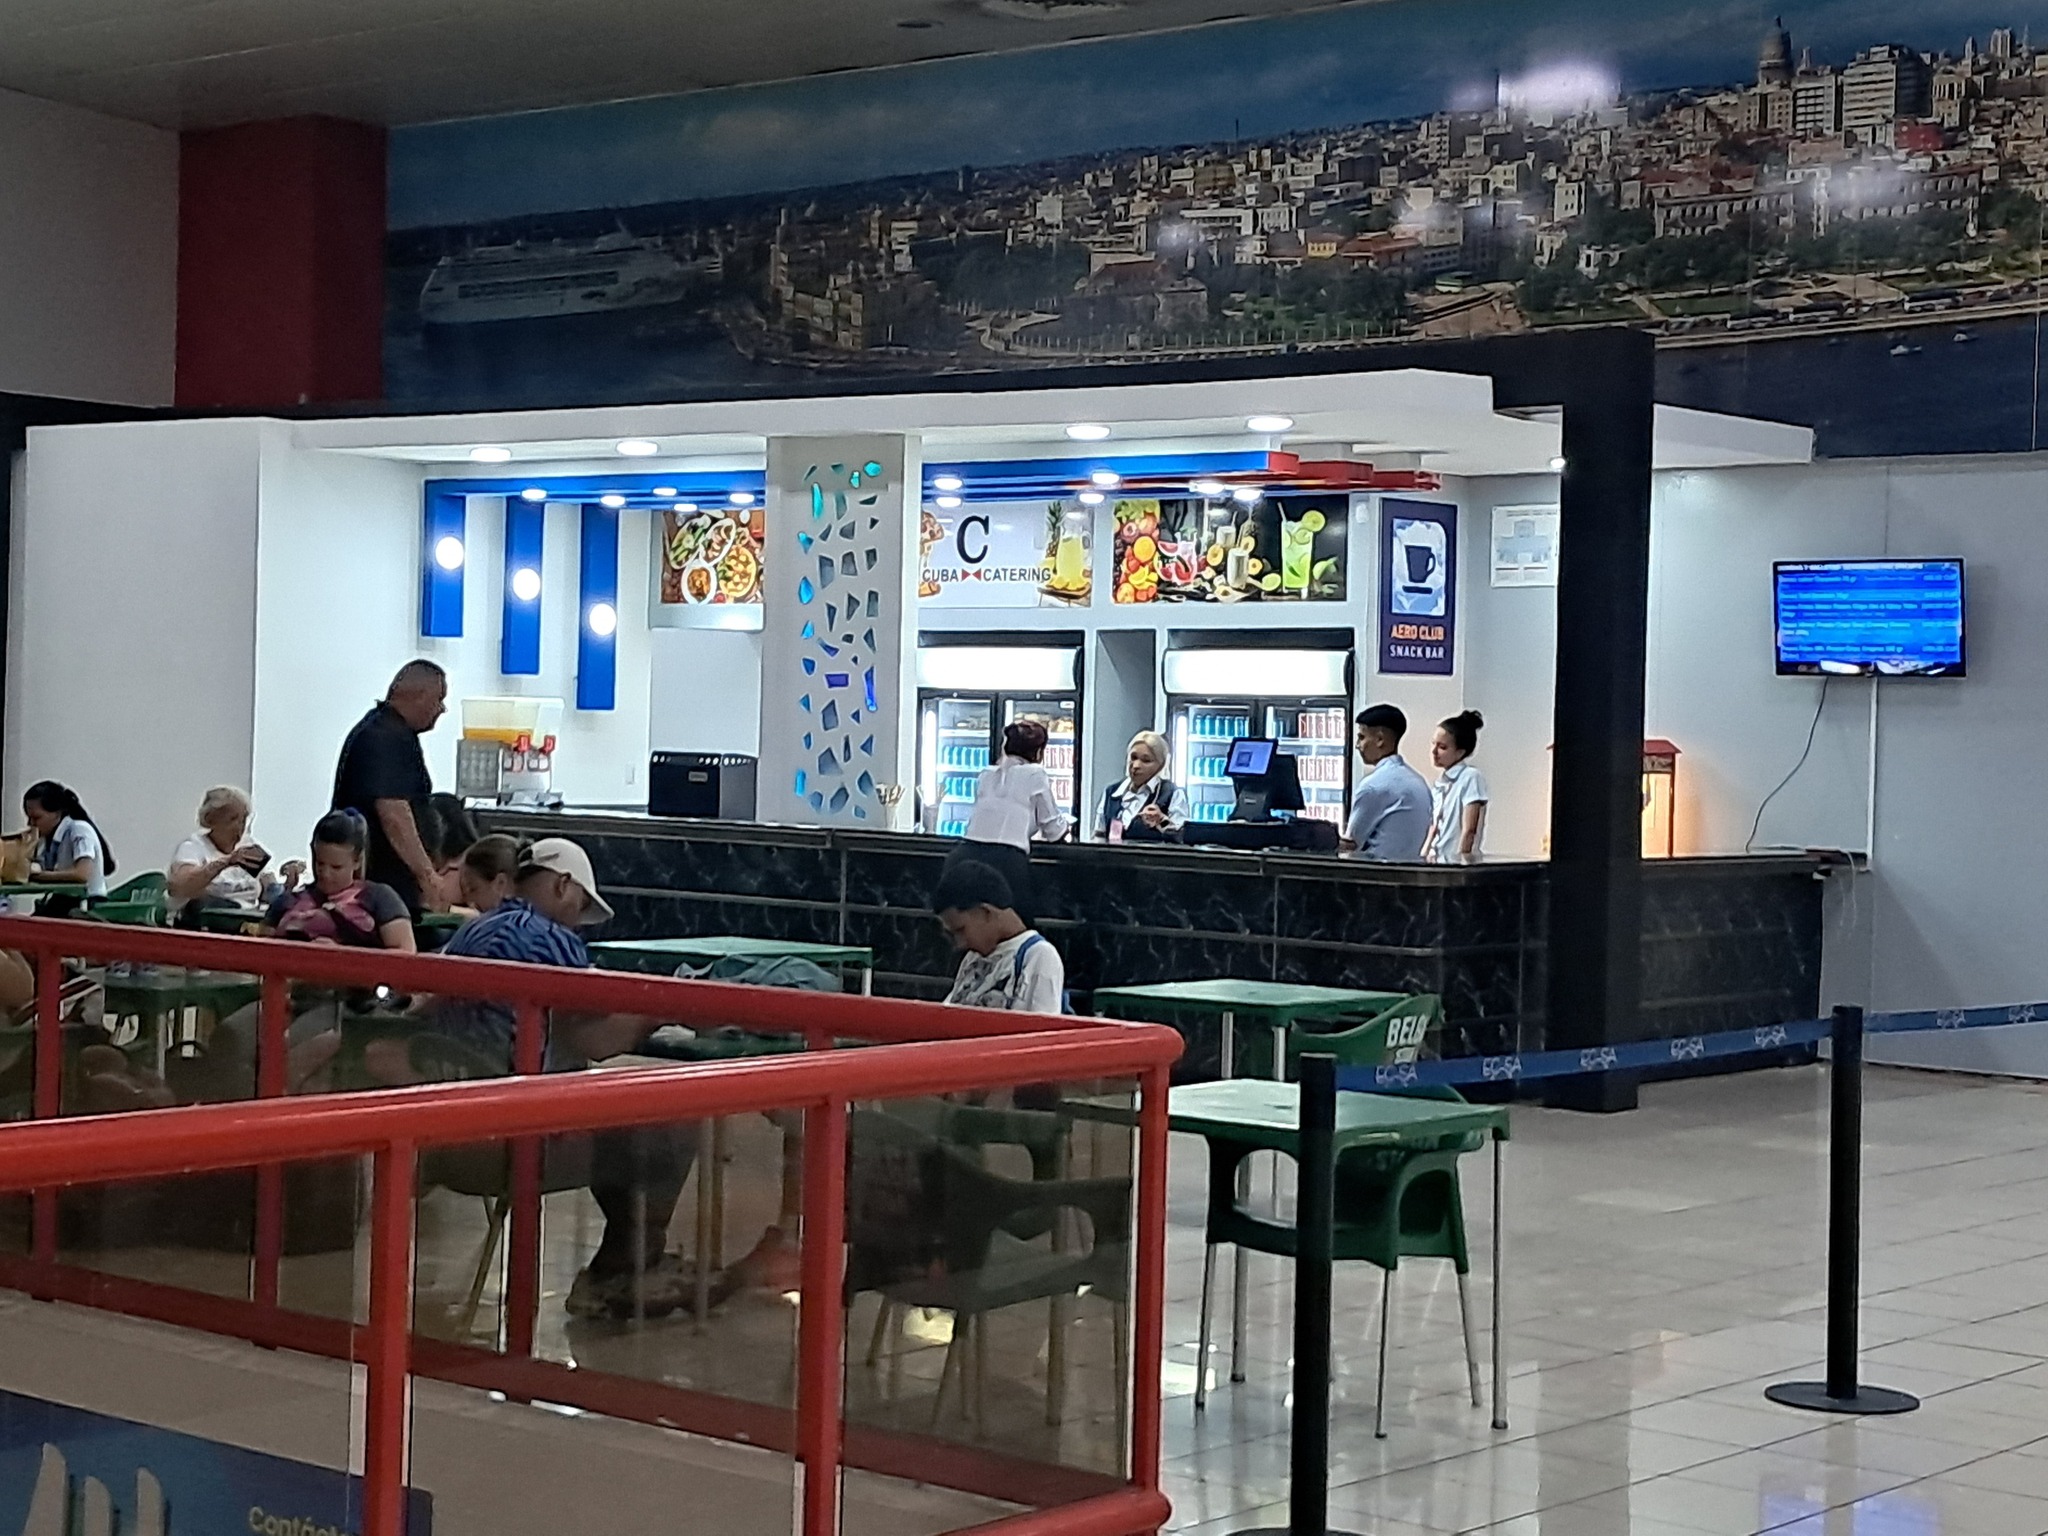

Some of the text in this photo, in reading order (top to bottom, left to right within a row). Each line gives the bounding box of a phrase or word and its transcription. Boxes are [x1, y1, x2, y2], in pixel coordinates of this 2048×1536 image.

[956, 515, 989, 564] C
[922, 567, 1051, 582] CUBA CATERING
[1391, 624, 1444, 640] AERO CLUB
[1389, 644, 1444, 659] SNACK BAR
